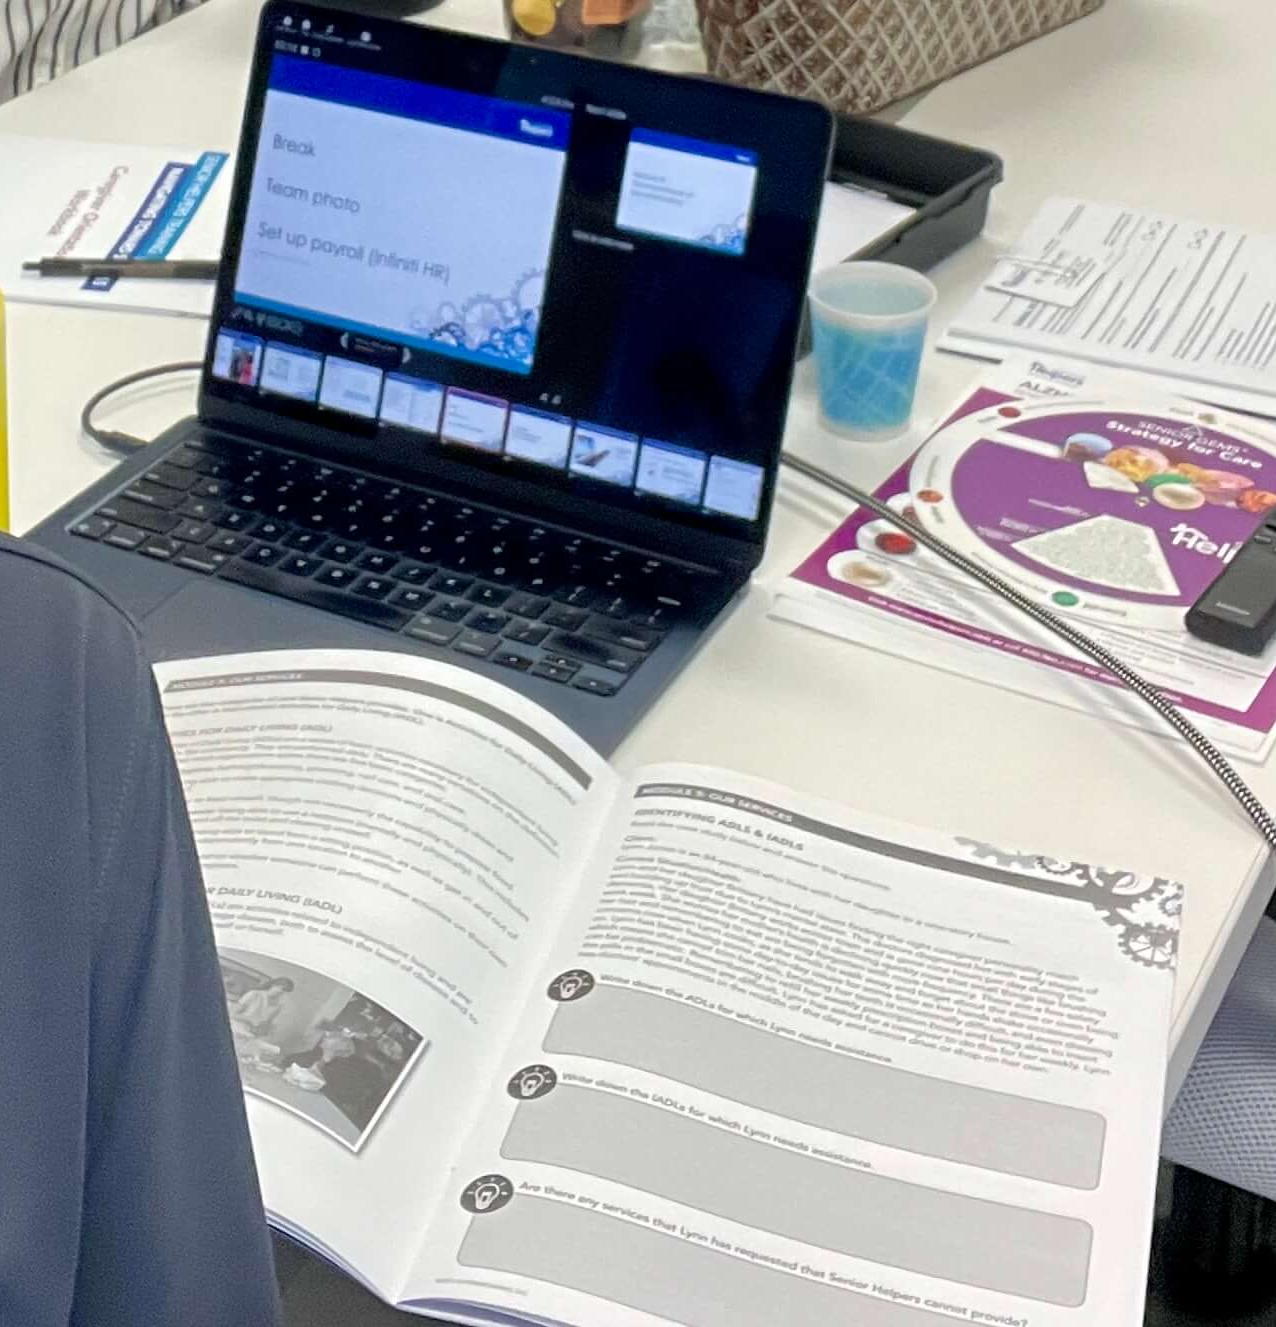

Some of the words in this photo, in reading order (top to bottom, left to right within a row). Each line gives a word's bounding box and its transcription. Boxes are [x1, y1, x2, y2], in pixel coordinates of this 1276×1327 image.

[272, 133, 316, 157] Break
[267, 176, 309, 201] Team
[312, 191, 361, 213] photo
[258, 222, 282, 240] Set
[286, 232, 308, 248] up
[311, 236, 365, 262] payroll
[1106, 420, 1183, 449] Strategy
[1187, 441, 1217, 456] for
[1219, 450, 1262, 469] Care
[217, 886, 254, 898] DAILY
[256, 887, 302, 905] LIVING
[664, 986, 684, 998] the
[717, 1002, 734, 1015] for
[595, 1078, 628, 1093] down
[630, 1085, 650, 1100] the
[688, 1105, 706, 1119] for
[708, 1115, 742, 1131] which
[743, 1125, 771, 1142] Lynn
[773, 1135, 810, 1153] needs
[518, 1180, 542, 1193] Are
[543, 1185, 576, 1201] there
[577, 1195, 600, 1209] any
[602, 1200, 651, 1224] services
[652, 1217, 678, 1234] that
[679, 1224, 709, 1243] Lynn
[710, 1235, 733, 1252] has
[733, 1245, 798, 1272] requested
[800, 1264, 826, 1280] that
[828, 1271, 870, 1290] Senior
[871, 1283, 922, 1305] Helpers
[923, 1297, 968, 1316] cannot
[969, 1309, 1029, 1327] provide?
